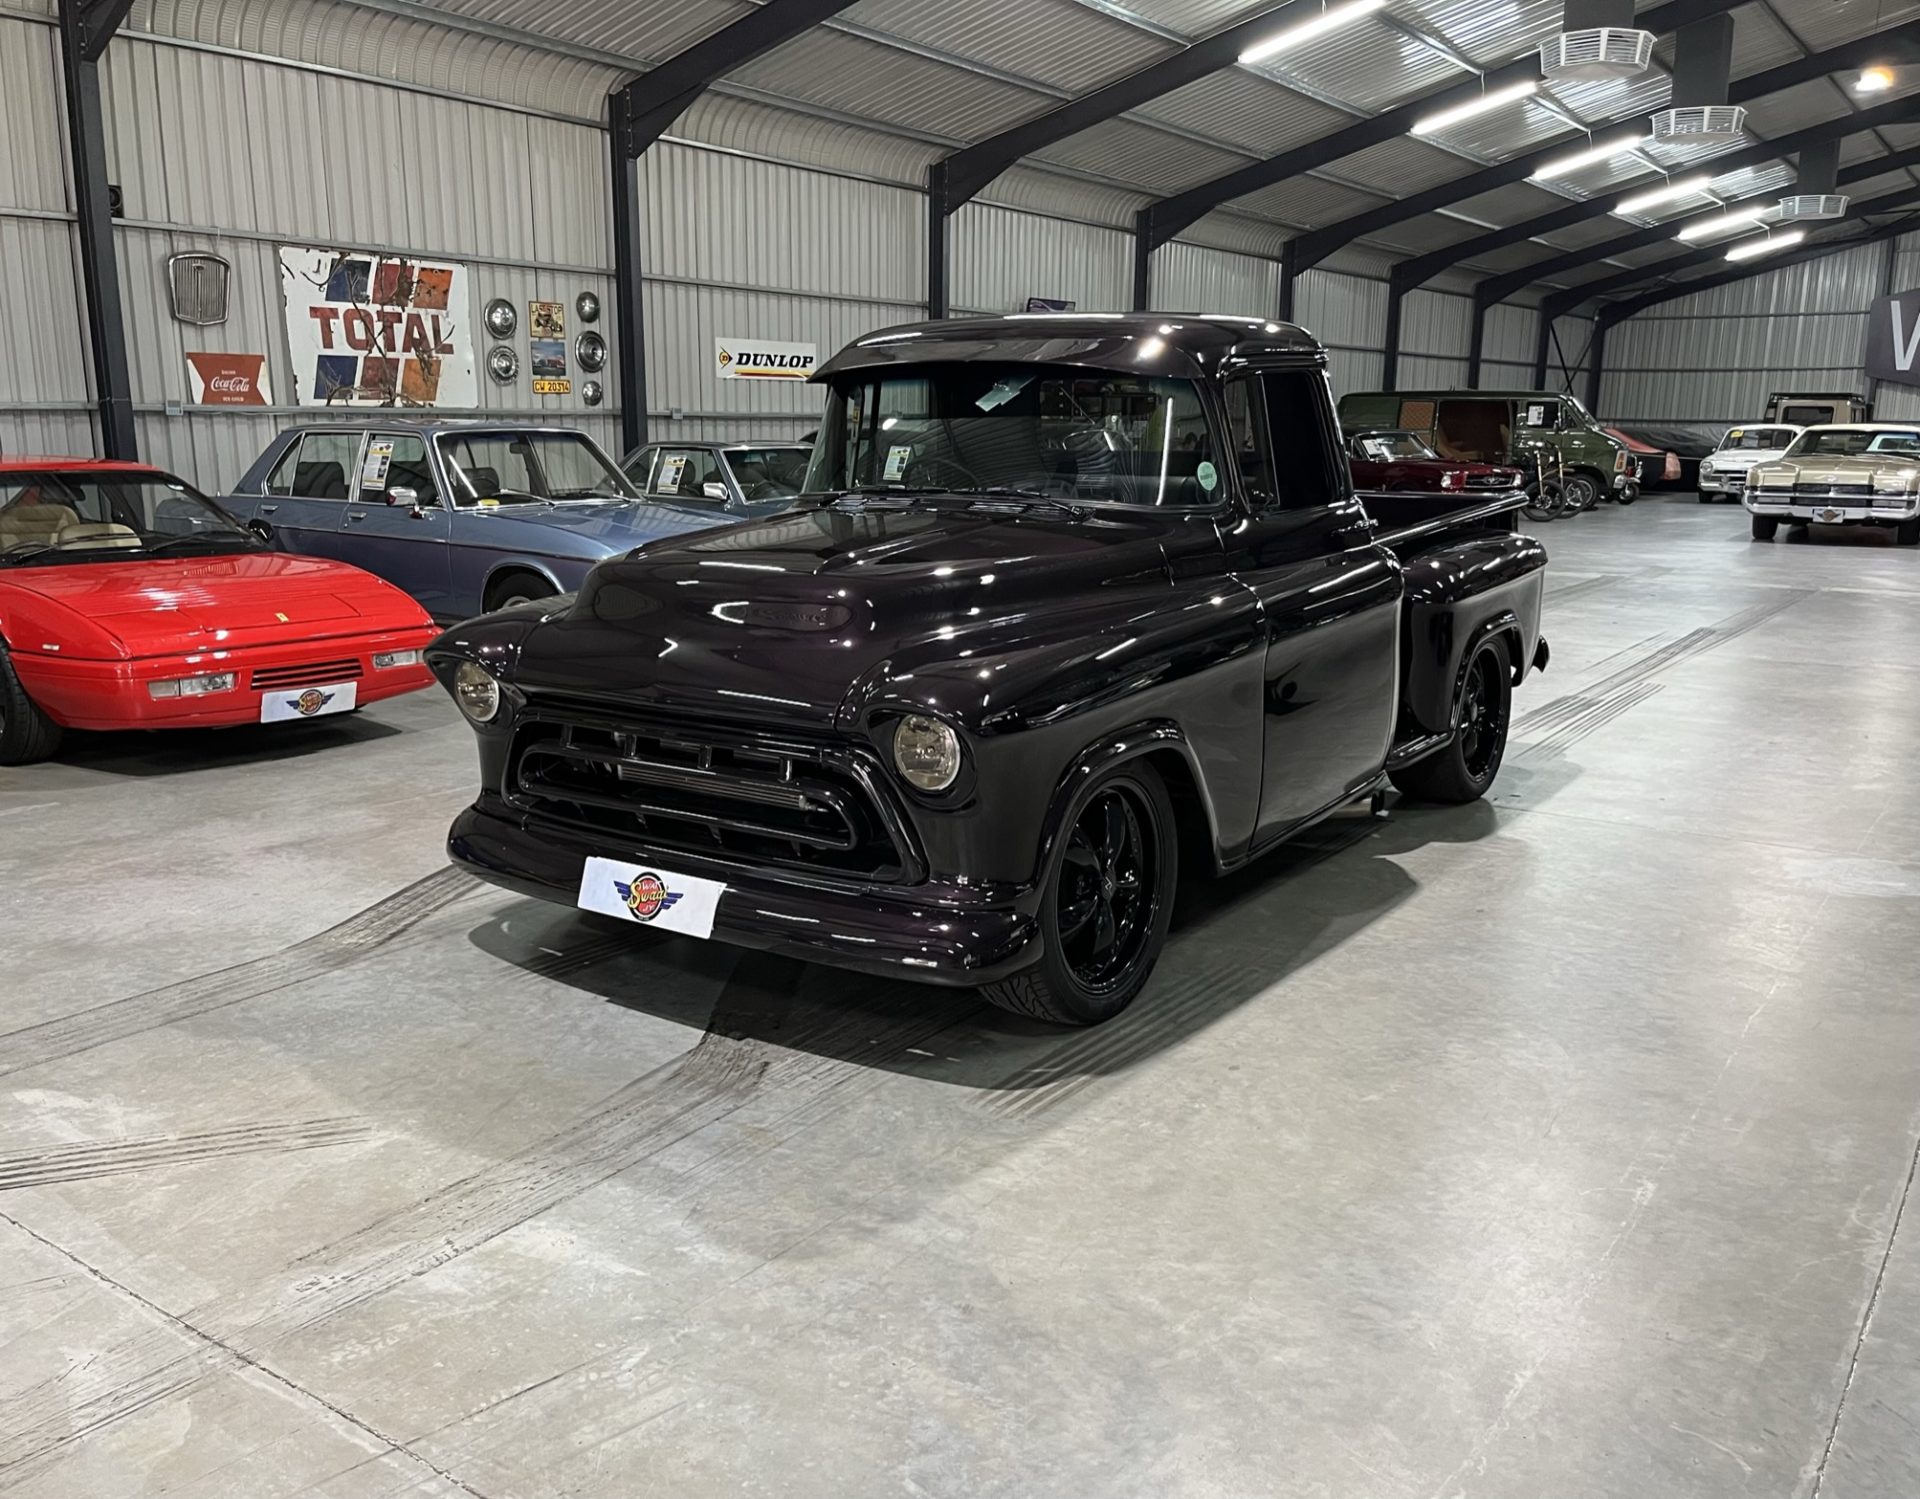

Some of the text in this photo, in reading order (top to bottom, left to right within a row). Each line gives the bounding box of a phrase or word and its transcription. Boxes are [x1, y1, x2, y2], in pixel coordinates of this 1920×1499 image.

[309, 306, 454, 354] TOTAL
[736, 352, 813, 368] DUNLOP
[534, 382, 545, 391] CW
